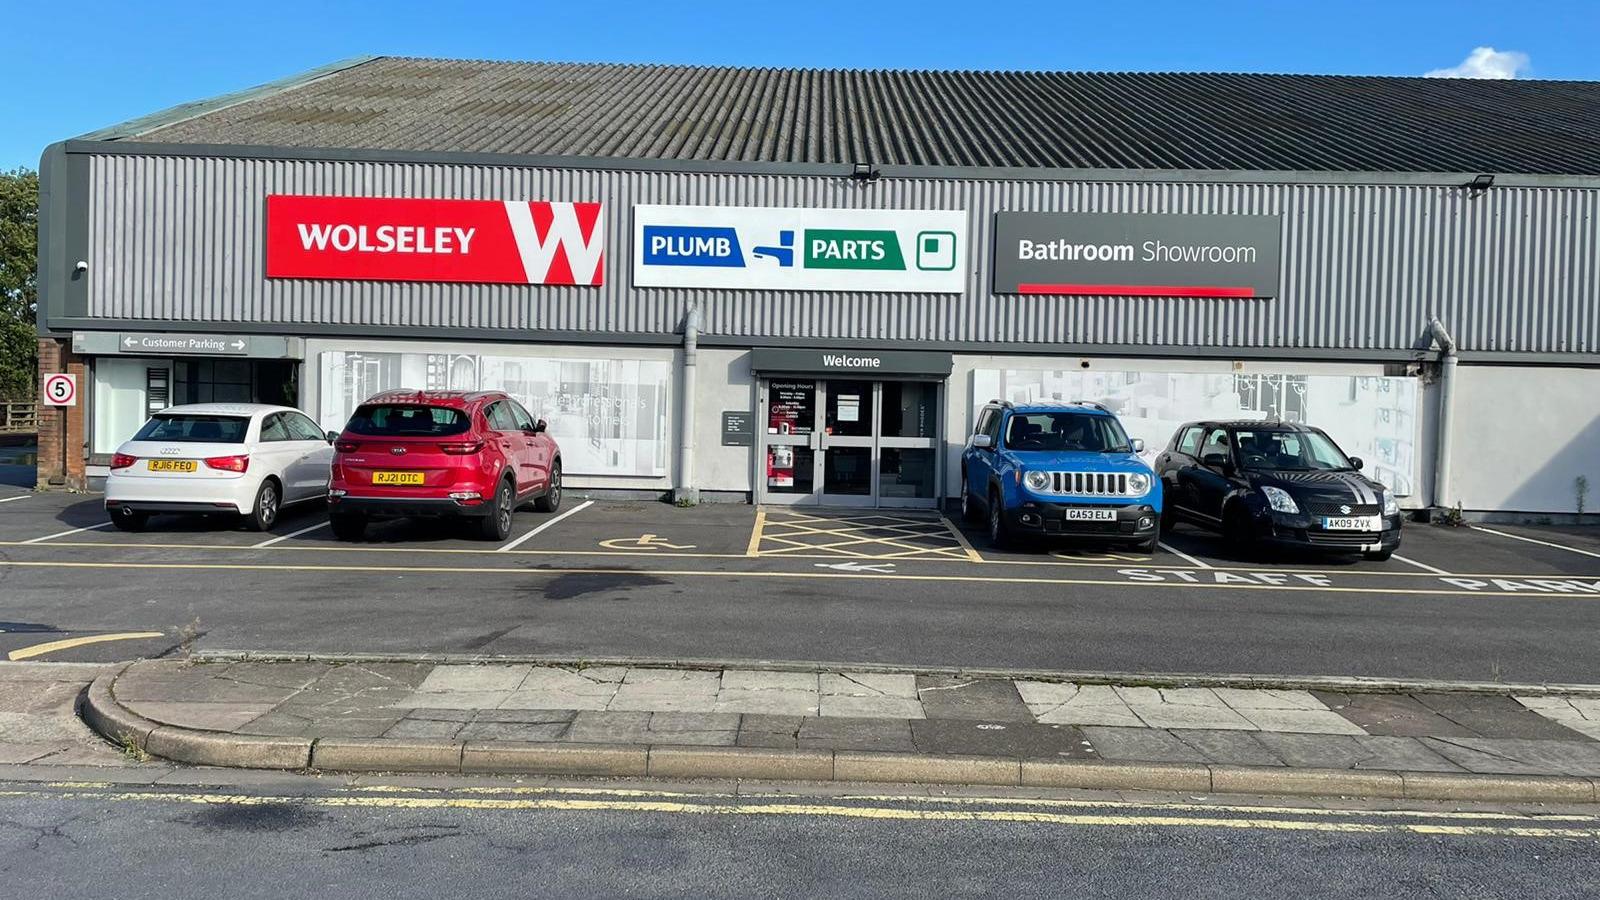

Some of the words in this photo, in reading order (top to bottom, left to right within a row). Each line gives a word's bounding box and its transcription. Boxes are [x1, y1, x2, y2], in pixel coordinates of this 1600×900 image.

[297, 223, 476, 254] WOLSELEY
[651, 235, 731, 258] PLUMB
[812, 239, 886, 261] PARTS
[1018, 239, 1134, 262] Bathroom
[1142, 240, 1256, 263] Showroom
[142, 337, 186, 348] Customer
[189, 338, 226, 351] Parking
[823, 354, 881, 368] Welcome
[54, 382, 66, 397] 5
[152, 459, 172, 470] RJ16
[173, 460, 192, 471] FEO
[377, 473, 399, 482] RJ21
[400, 473, 419, 482] OTC
[1069, 510, 1094, 519] GA53
[1095, 511, 1113, 520] ELA
[1328, 519, 1352, 528] AK09
[1354, 519, 1371, 528] ZVX
[1117, 569, 1333, 587] STAFF
